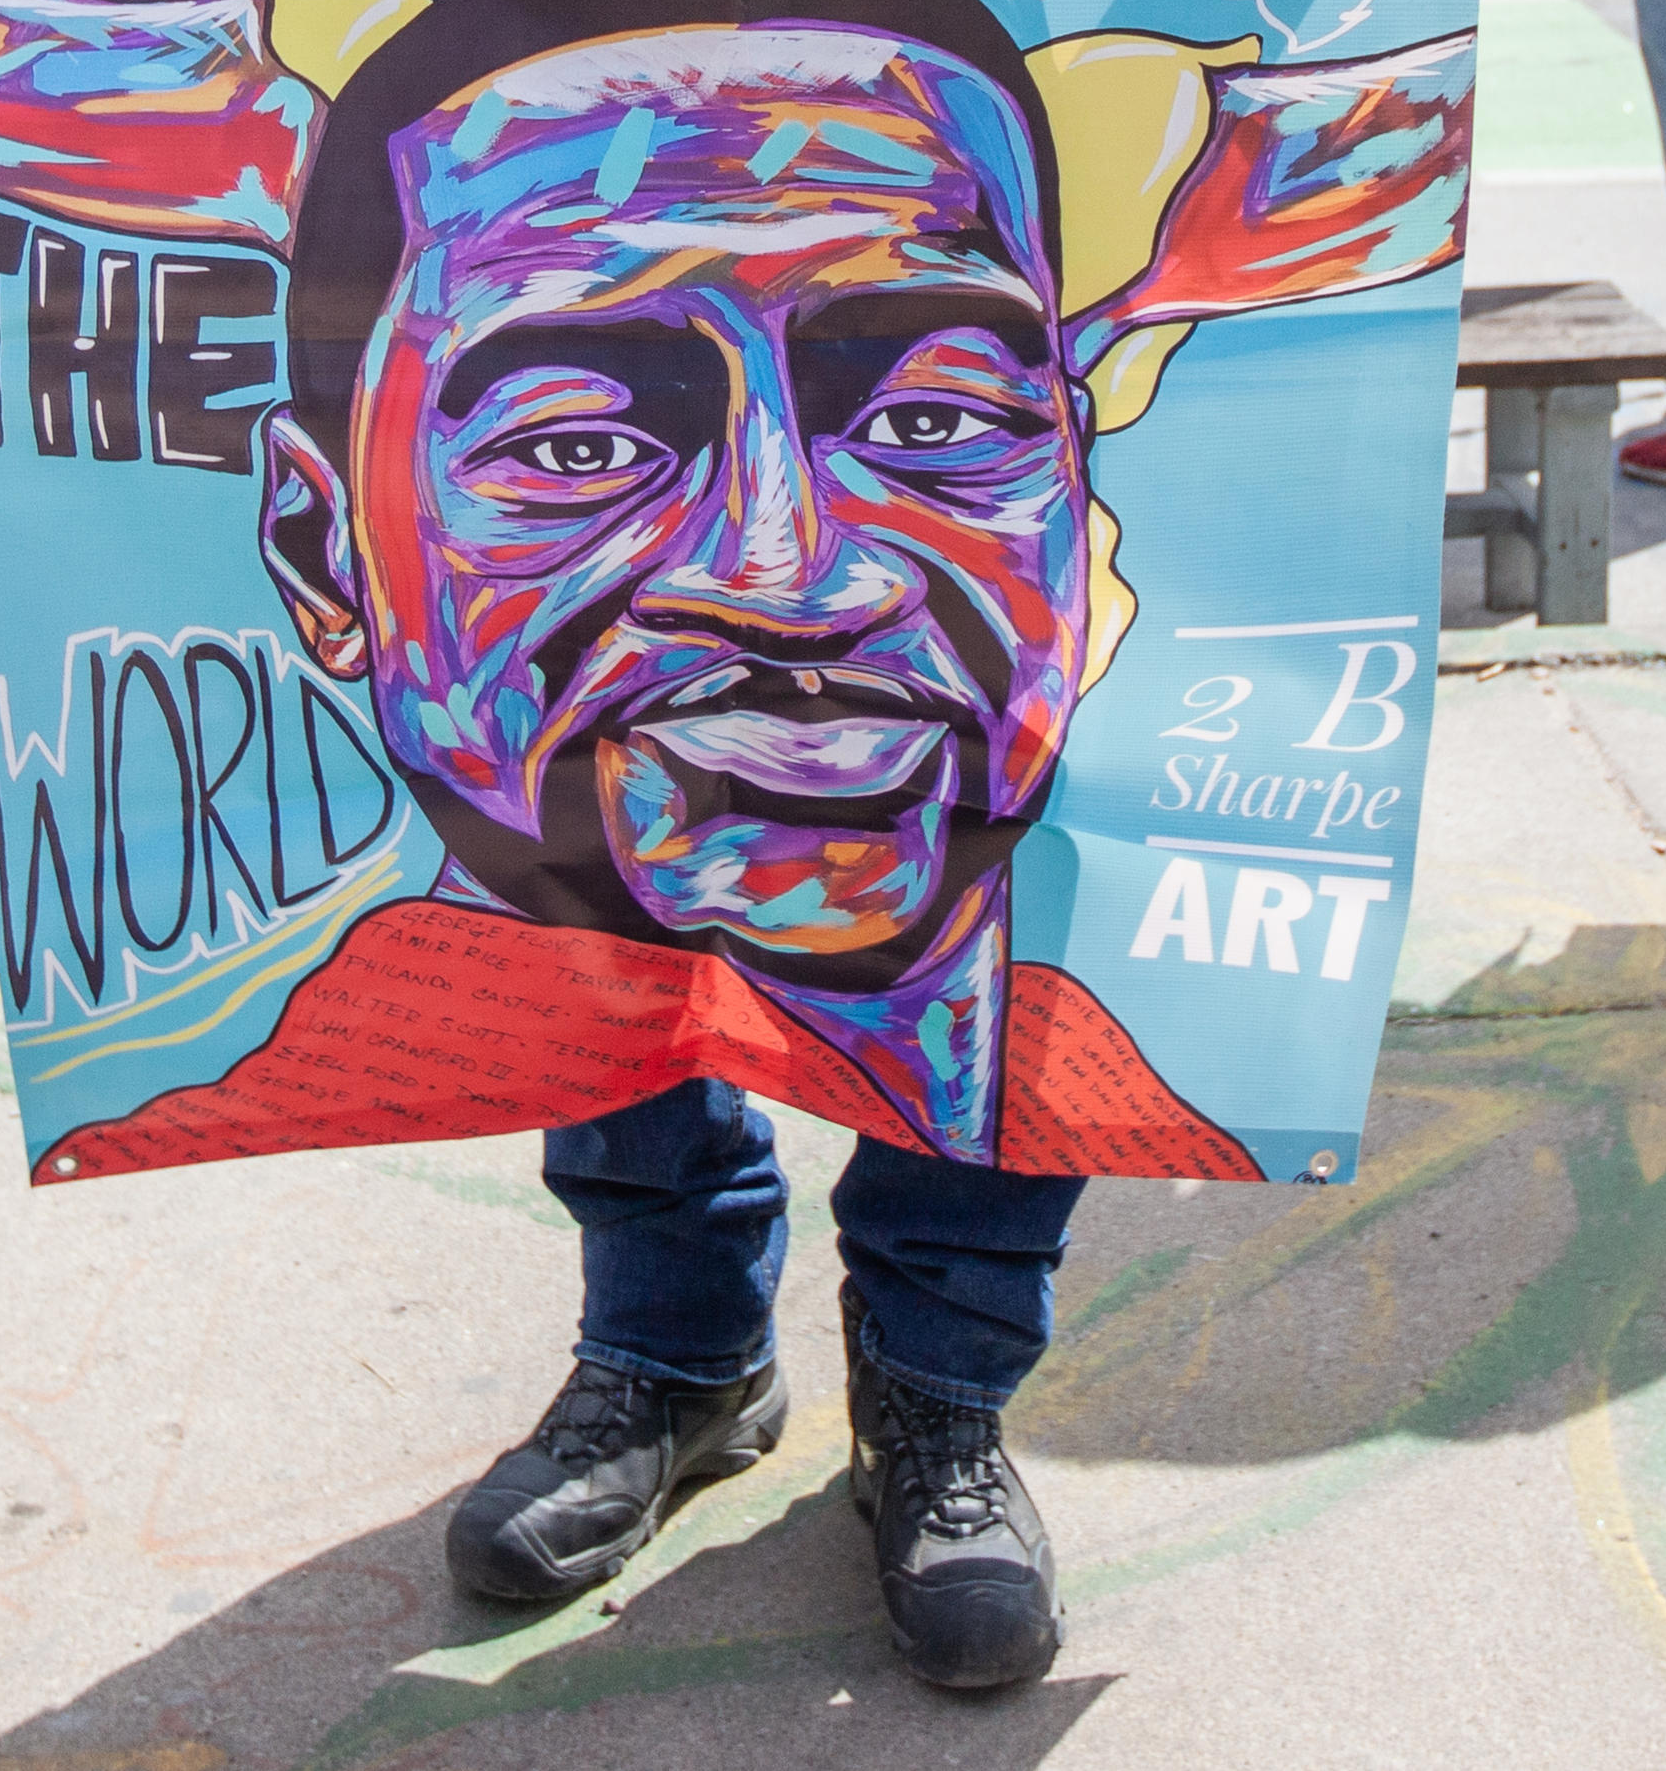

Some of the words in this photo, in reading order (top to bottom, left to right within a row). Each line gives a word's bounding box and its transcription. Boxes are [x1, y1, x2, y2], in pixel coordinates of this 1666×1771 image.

[1158, 674, 1254, 743] 2
[1290, 640, 1418, 753] B
[1149, 753, 1403, 840] Sharpe
[366, 917, 452, 955] TAMIR
[462, 944, 512, 972] RICE
[400, 908, 504, 940] GEORGE
[1128, 856, 1392, 983] ART
[313, 982, 422, 1023] WALTER
[437, 1016, 521, 1045] SCOTT
[343, 953, 454, 992] PHILANDO
[471, 987, 562, 1019] CASTILE
[1015, 969, 1099, 1024] FREDDIE
[293, 1011, 361, 1042] JOHN
